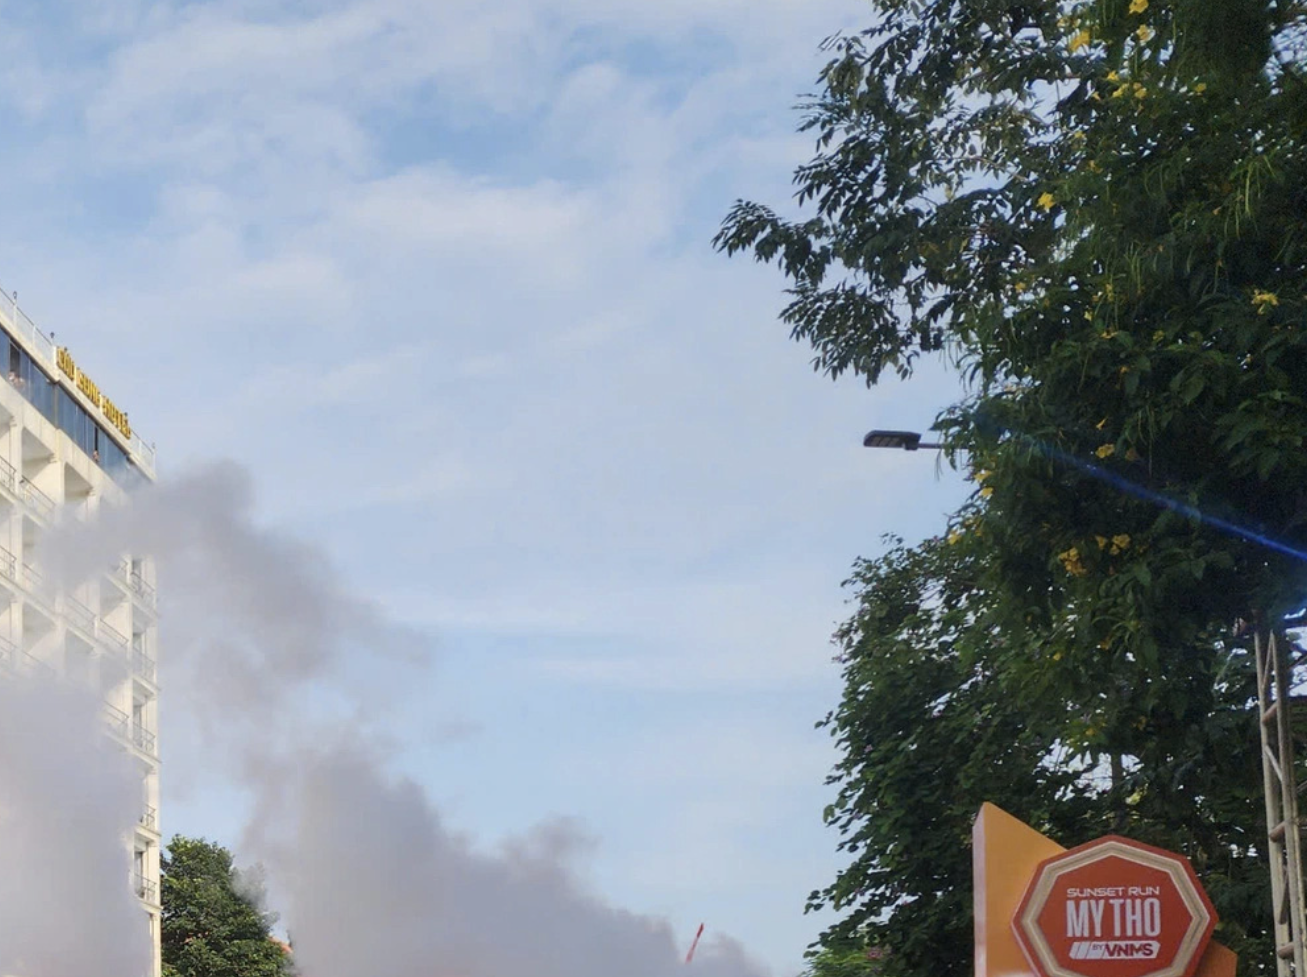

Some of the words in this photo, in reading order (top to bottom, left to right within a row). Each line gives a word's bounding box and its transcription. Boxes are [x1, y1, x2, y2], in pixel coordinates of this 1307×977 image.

[1066, 887, 1125, 898] SUNSET
[1128, 886, 1160, 896] RUN
[1066, 899, 1105, 938] MY
[1109, 897, 1161, 937] THO
[1104, 943, 1154, 957] VNMS
